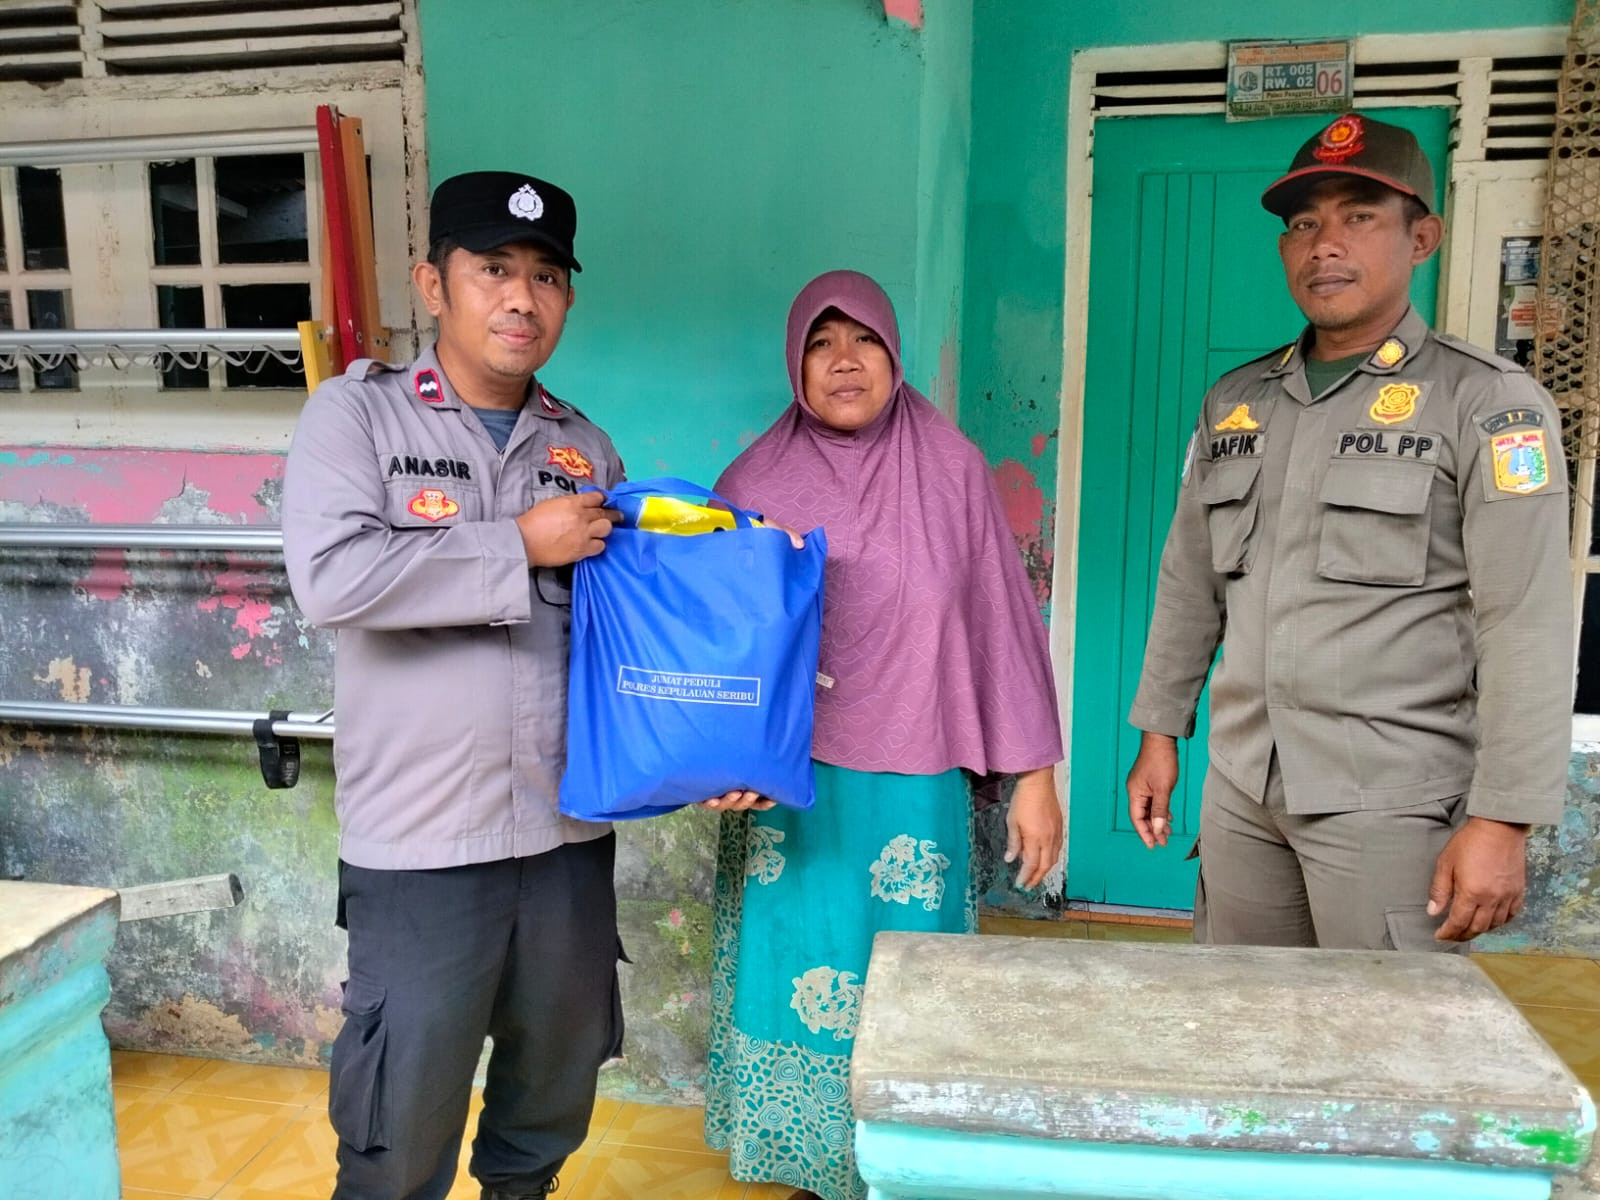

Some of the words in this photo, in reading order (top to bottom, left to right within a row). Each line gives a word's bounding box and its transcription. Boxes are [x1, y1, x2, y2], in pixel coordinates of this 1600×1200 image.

[1265, 66, 1286, 78] RT.
[1289, 64, 1314, 76] 005
[1265, 78, 1290, 89] RW.
[1296, 76, 1314, 87] 02
[1317, 70, 1342, 95] 06
[1339, 432, 1389, 455] POL
[1397, 435, 1434, 459] PP
[388, 455, 472, 481] ANASIR
[651, 674, 682, 686] JUMAT
[683, 677, 721, 688] PEDULI
[657, 685, 715, 699] KEPULAUAN
[716, 690, 755, 701] SERIBU
